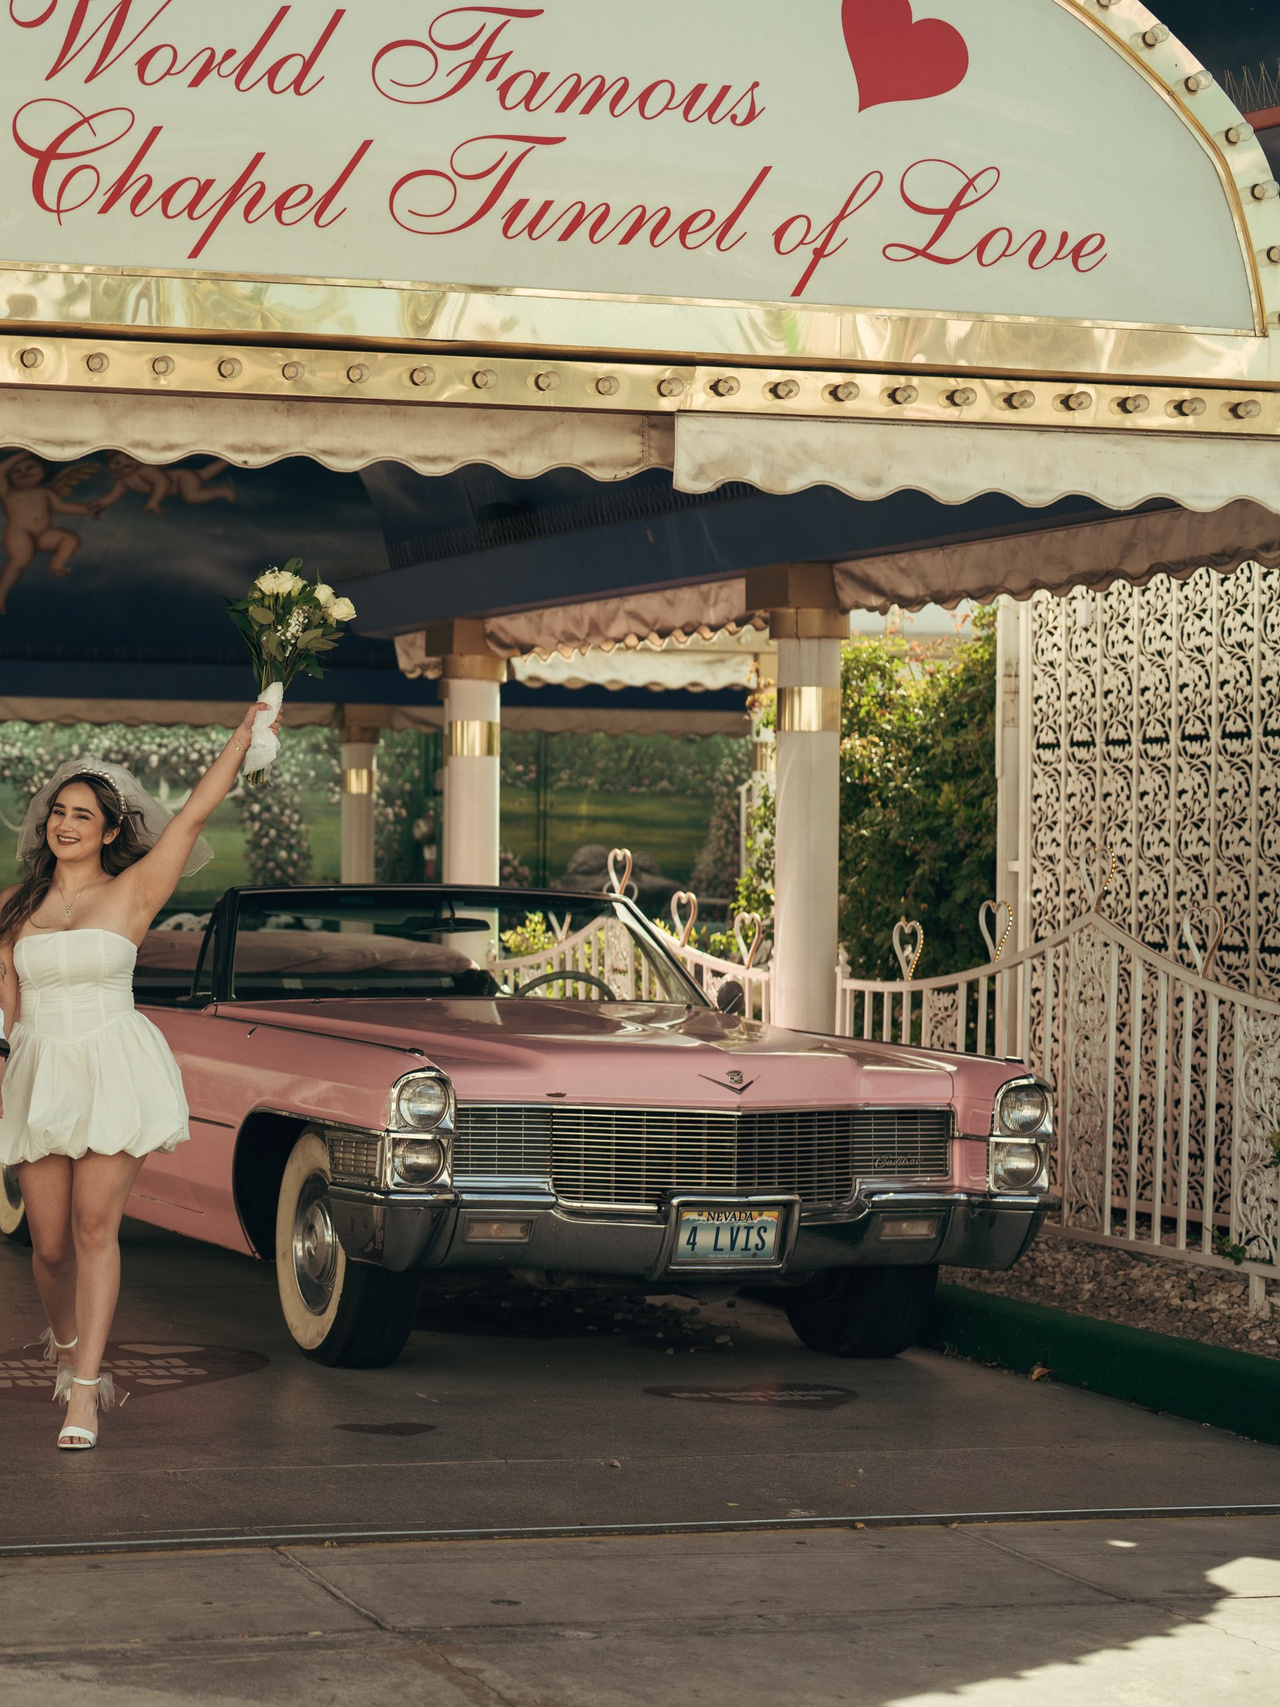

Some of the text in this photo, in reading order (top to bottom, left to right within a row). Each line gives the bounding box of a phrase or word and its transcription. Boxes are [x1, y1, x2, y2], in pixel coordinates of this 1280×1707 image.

[7, 0, 348, 97] World
[370, 6, 766, 127] Famous
[11, 97, 374, 260] Chapel
[387, 133, 774, 253] Tunnel
[771, 170, 886, 298] of
[880, 157, 1110, 274] Love
[685, 1226, 768, 1252] 4 LVIS
[706, 1211, 754, 1222] NEVADA
